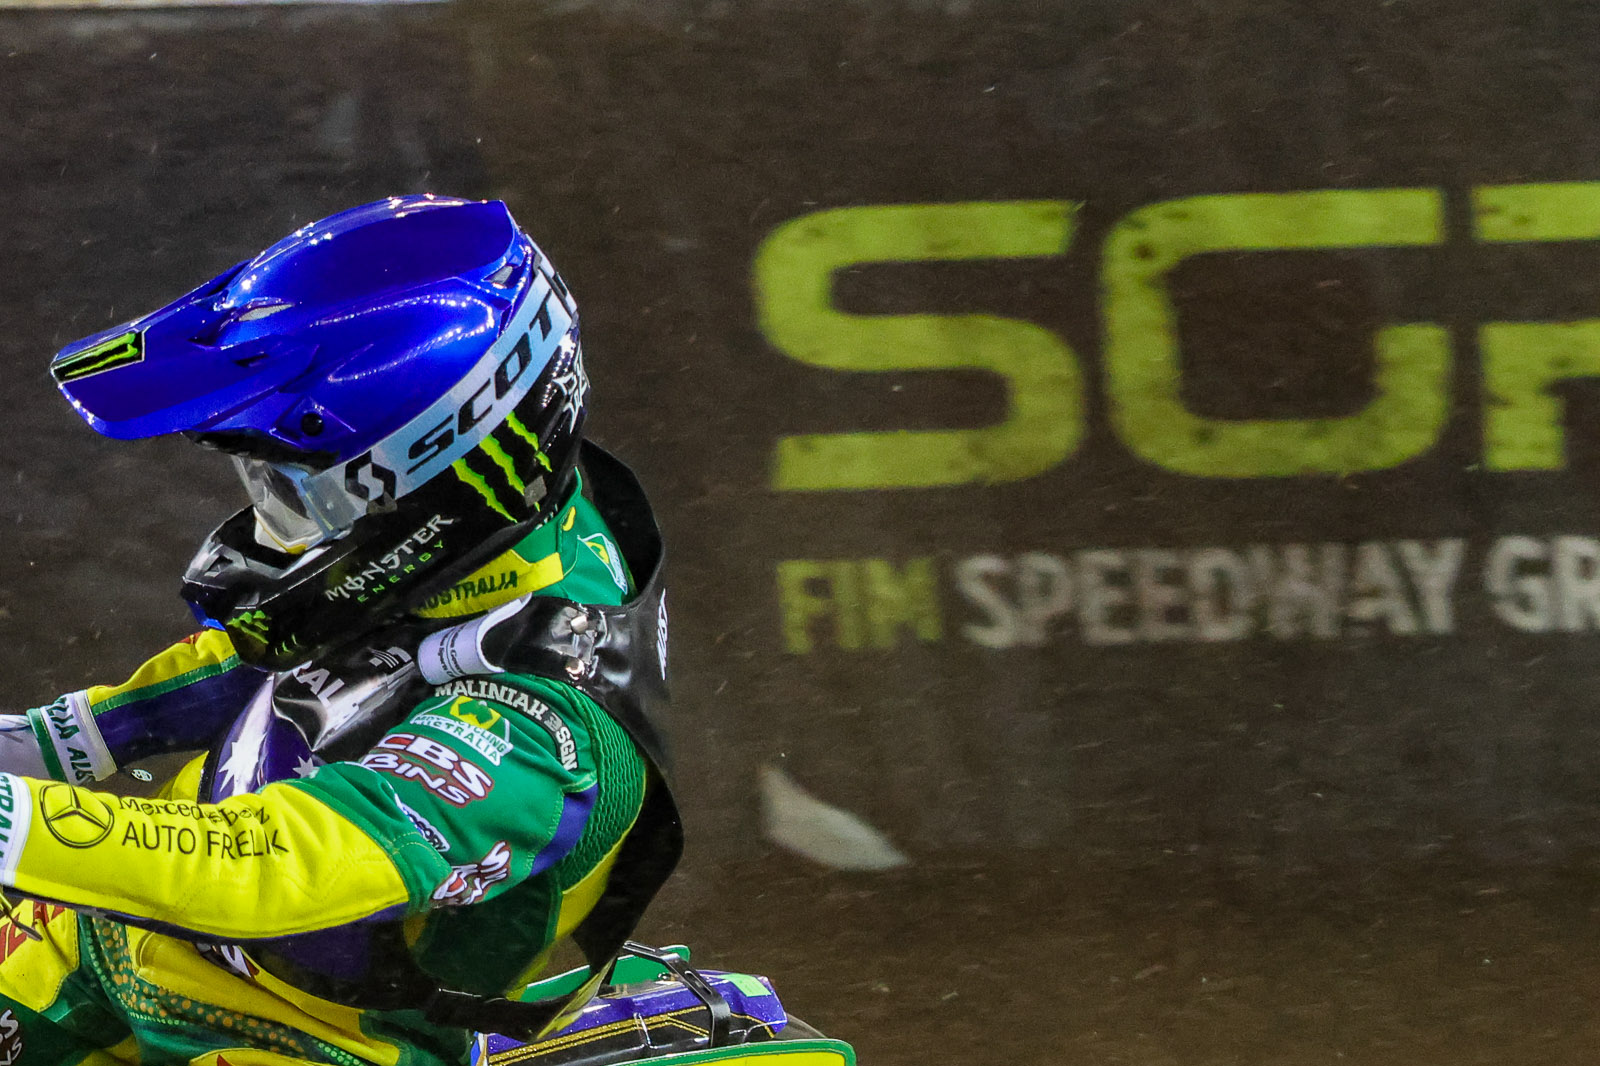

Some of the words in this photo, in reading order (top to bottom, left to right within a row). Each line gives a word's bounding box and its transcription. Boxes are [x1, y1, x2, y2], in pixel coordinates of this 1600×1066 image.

[356, 539, 444, 604] ENERGY
[776, 557, 943, 655] FIM
[949, 538, 1465, 652] SPEEDWAY
[434, 679, 549, 721] MALINIAK
[361, 752, 470, 805] BINS
[376, 733, 493, 798] CBS
[121, 820, 197, 855] AUTO
